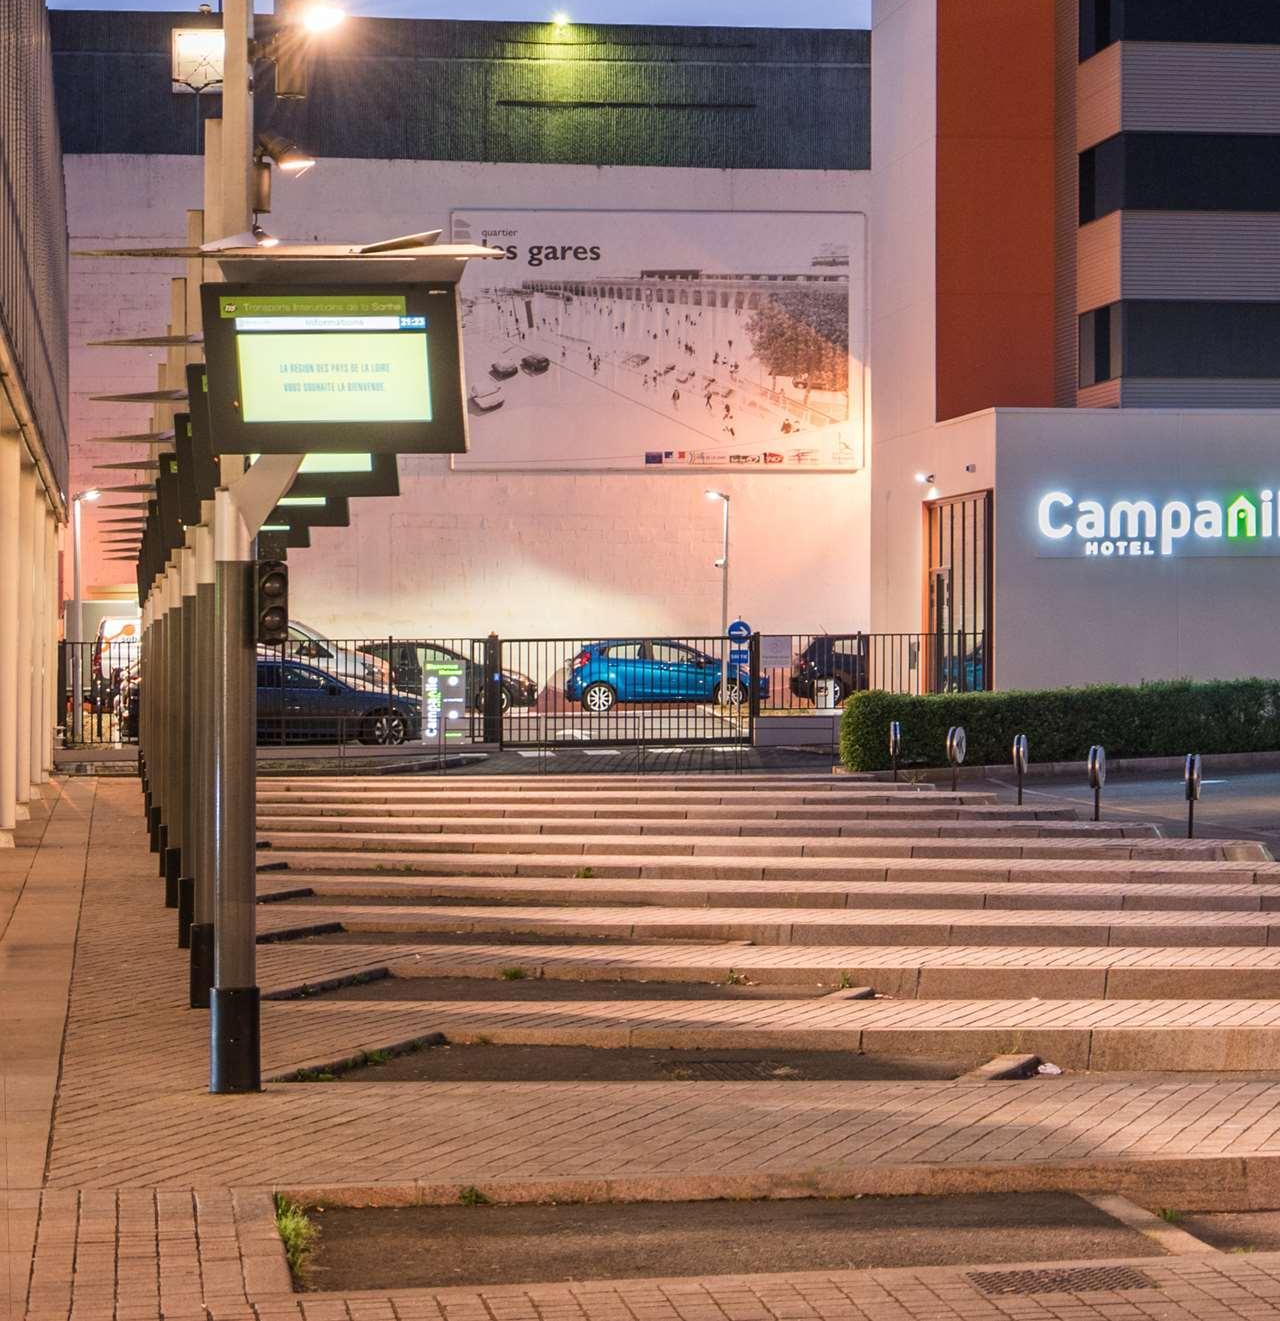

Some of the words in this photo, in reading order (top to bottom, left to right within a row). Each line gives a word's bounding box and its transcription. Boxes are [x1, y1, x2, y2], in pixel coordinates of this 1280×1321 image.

[481, 229, 518, 238] quartier
[527, 244, 601, 267] gares
[244, 302, 290, 313] Transports
[371, 302, 402, 312] Sarthe
[279, 363, 289, 374] LA
[316, 363, 330, 374] DES
[331, 362, 349, 373] PAYS
[350, 362, 359, 373] DE
[361, 362, 370, 373] LA
[371, 362, 391, 373] LOIRE
[283, 382, 301, 393] VOUS
[303, 382, 336, 392] SOUHAITE
[337, 382, 346, 392] LA
[1085, 541, 1154, 555] HOTEL
[425, 676, 441, 737] Campanile
